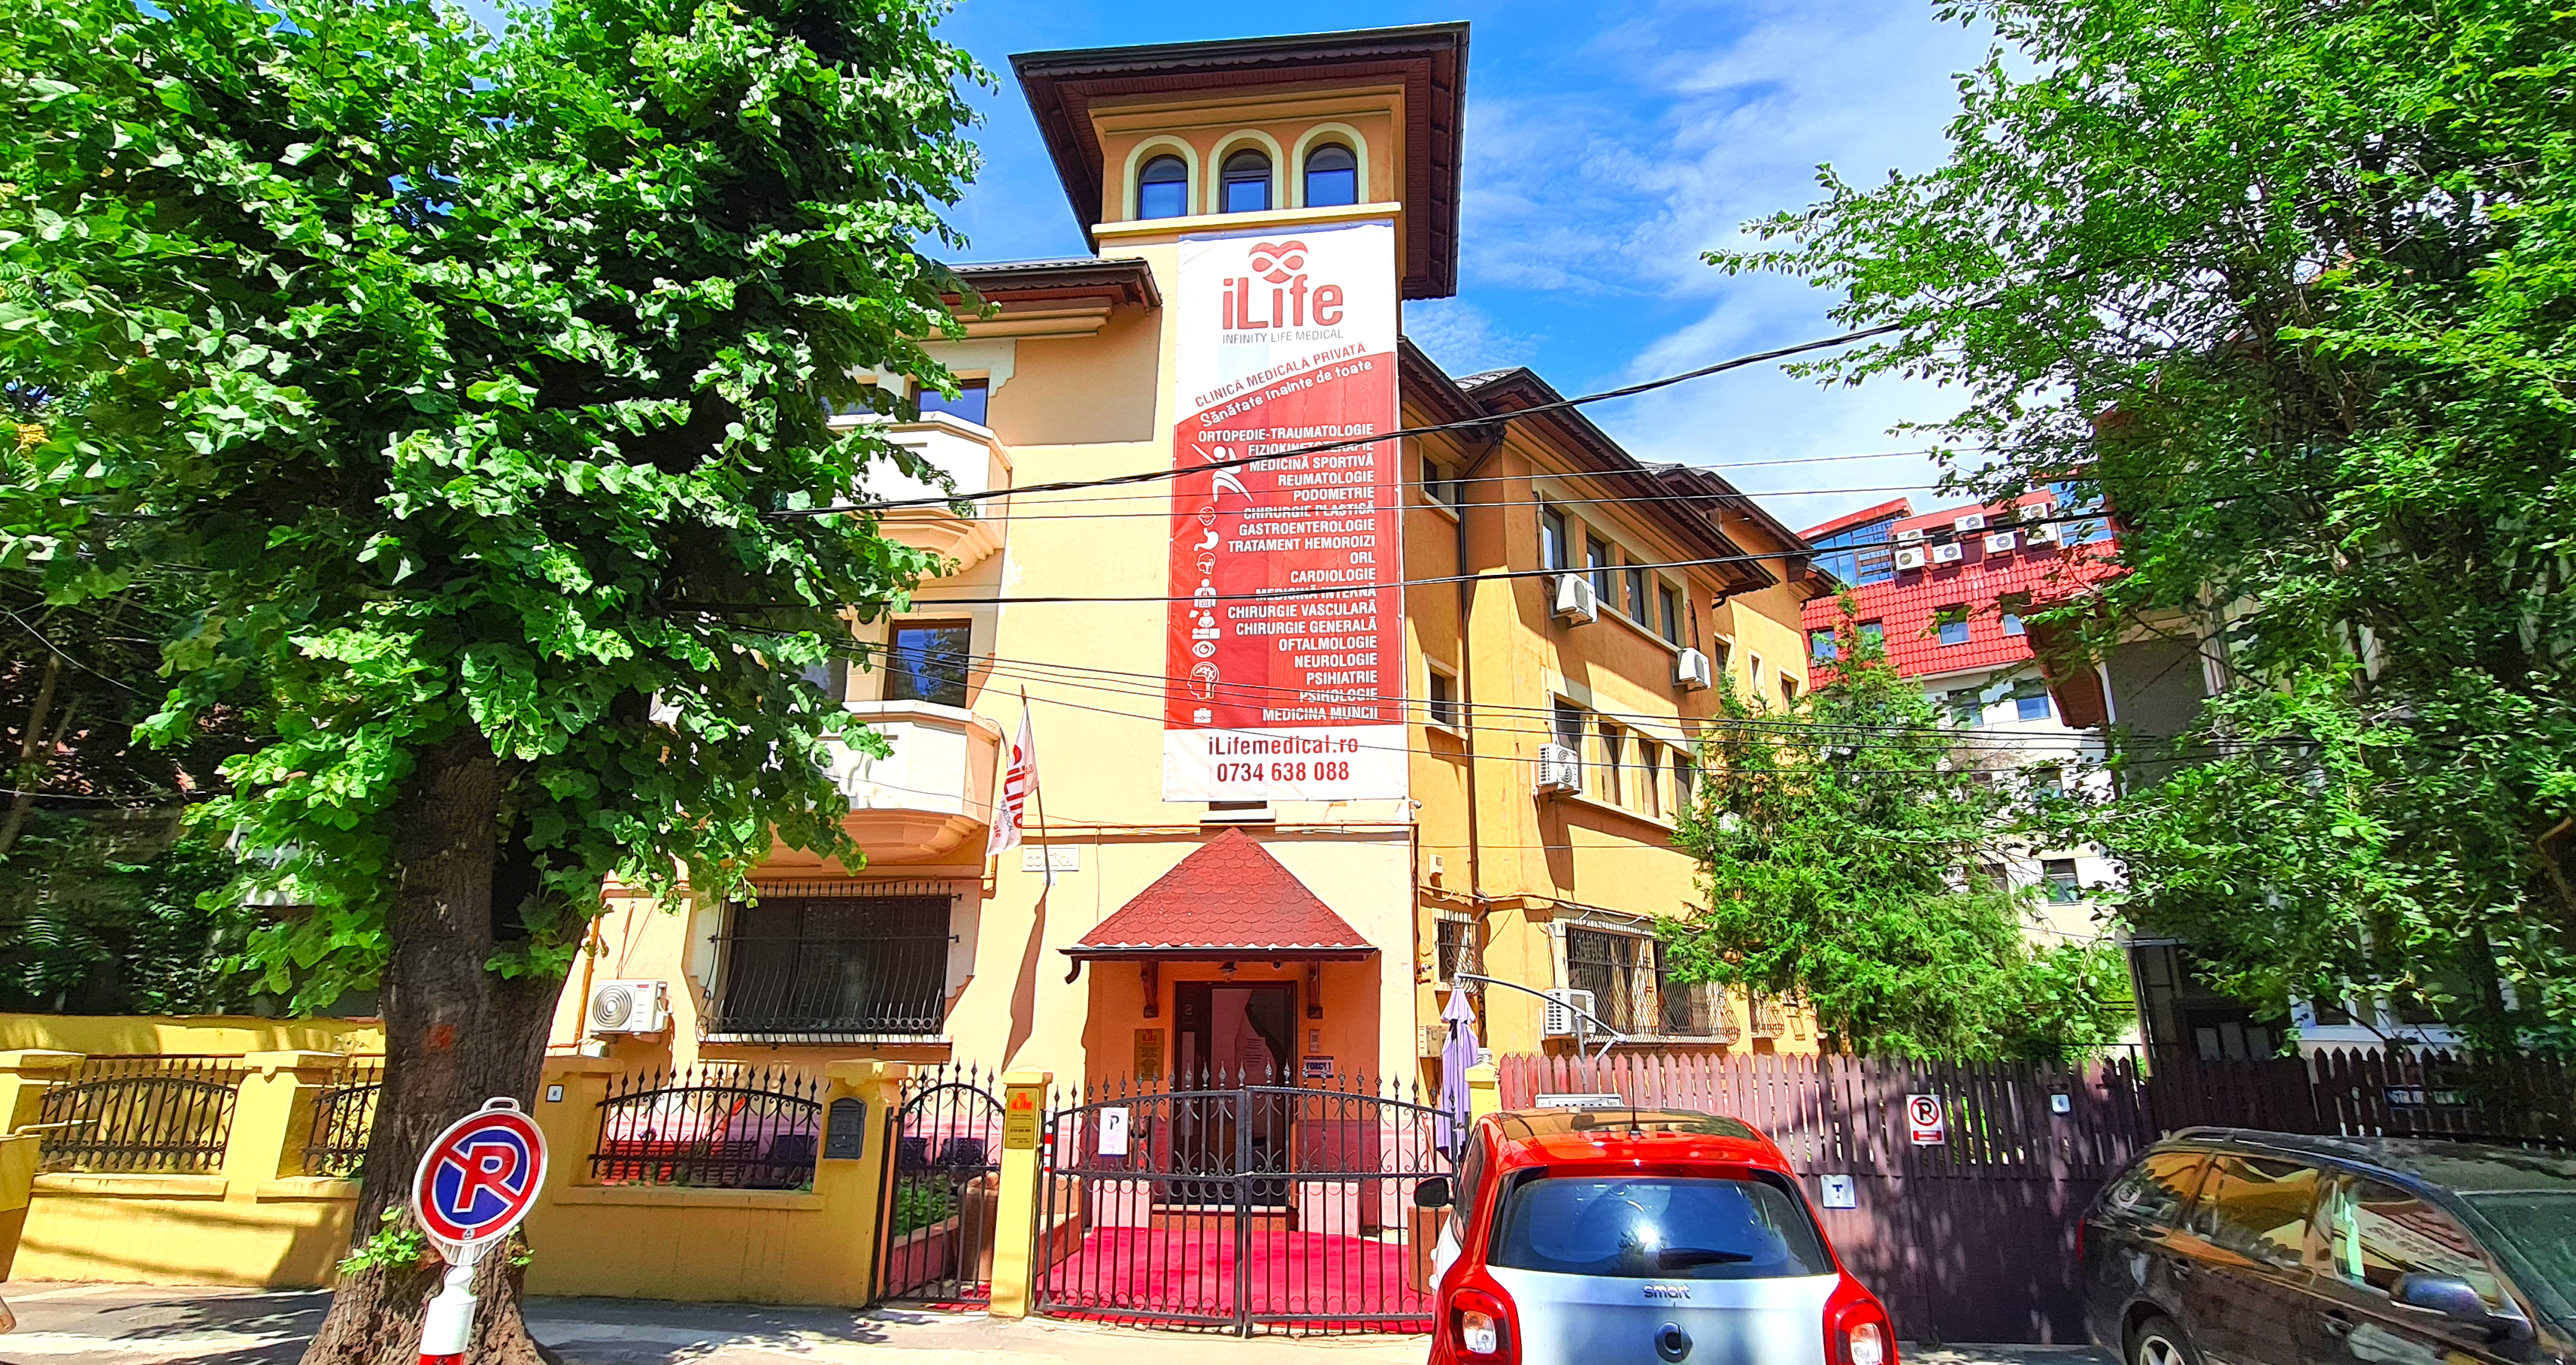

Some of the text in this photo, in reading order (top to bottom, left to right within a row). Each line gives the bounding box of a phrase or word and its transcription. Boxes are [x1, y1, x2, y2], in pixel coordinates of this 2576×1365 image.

[1223, 274, 1343, 330] iLife
[1223, 329, 1344, 344] INFINITY LIFE MEDICAL
[1195, 342, 1366, 407] CLINICĂ MEDICALĂ PRIVATĂ
[1316, 368, 1332, 384] de
[1335, 359, 1373, 378] toate
[1198, 423, 1374, 443] ORTOPEDIE-TRAUMATOLOGIE
[1248, 440, 1374, 456] FIZIOKINETOAPIE
[1249, 452, 1374, 472] MEDICINĂ SPORTIVĂ
[1277, 470, 1374, 486] REUMATOLOGIE
[1293, 486, 1374, 502] PODOMETRIE
[1243, 506, 1311, 520] CHIRURGIE
[1239, 518, 1375, 536] GASTROENTEROLOGIE
[1227, 534, 1375, 553] TRATAMENT HEMOROIZI
[1350, 551, 1376, 564] ORL
[1290, 567, 1376, 583] CARDIOLOGIE
[1227, 600, 1377, 619] CHIRURGIE VASCULARĂ
[1235, 617, 1377, 636] CHIRURGIE GENERALĂ
[1278, 635, 1377, 652] OFTALMOLOGIE
[1294, 652, 1377, 668] NEUROLOGIE
[1306, 670, 1378, 686] PSIHIATRIE
[1299, 687, 1378, 703] PSIHOLOGIE
[1262, 706, 1378, 722] MEDICINA MUNCII
[1208, 734, 1359, 755] iLifemedical.ro
[1217, 761, 1350, 782] 0734 638 088
[1644, 1284, 1690, 1299] smart
